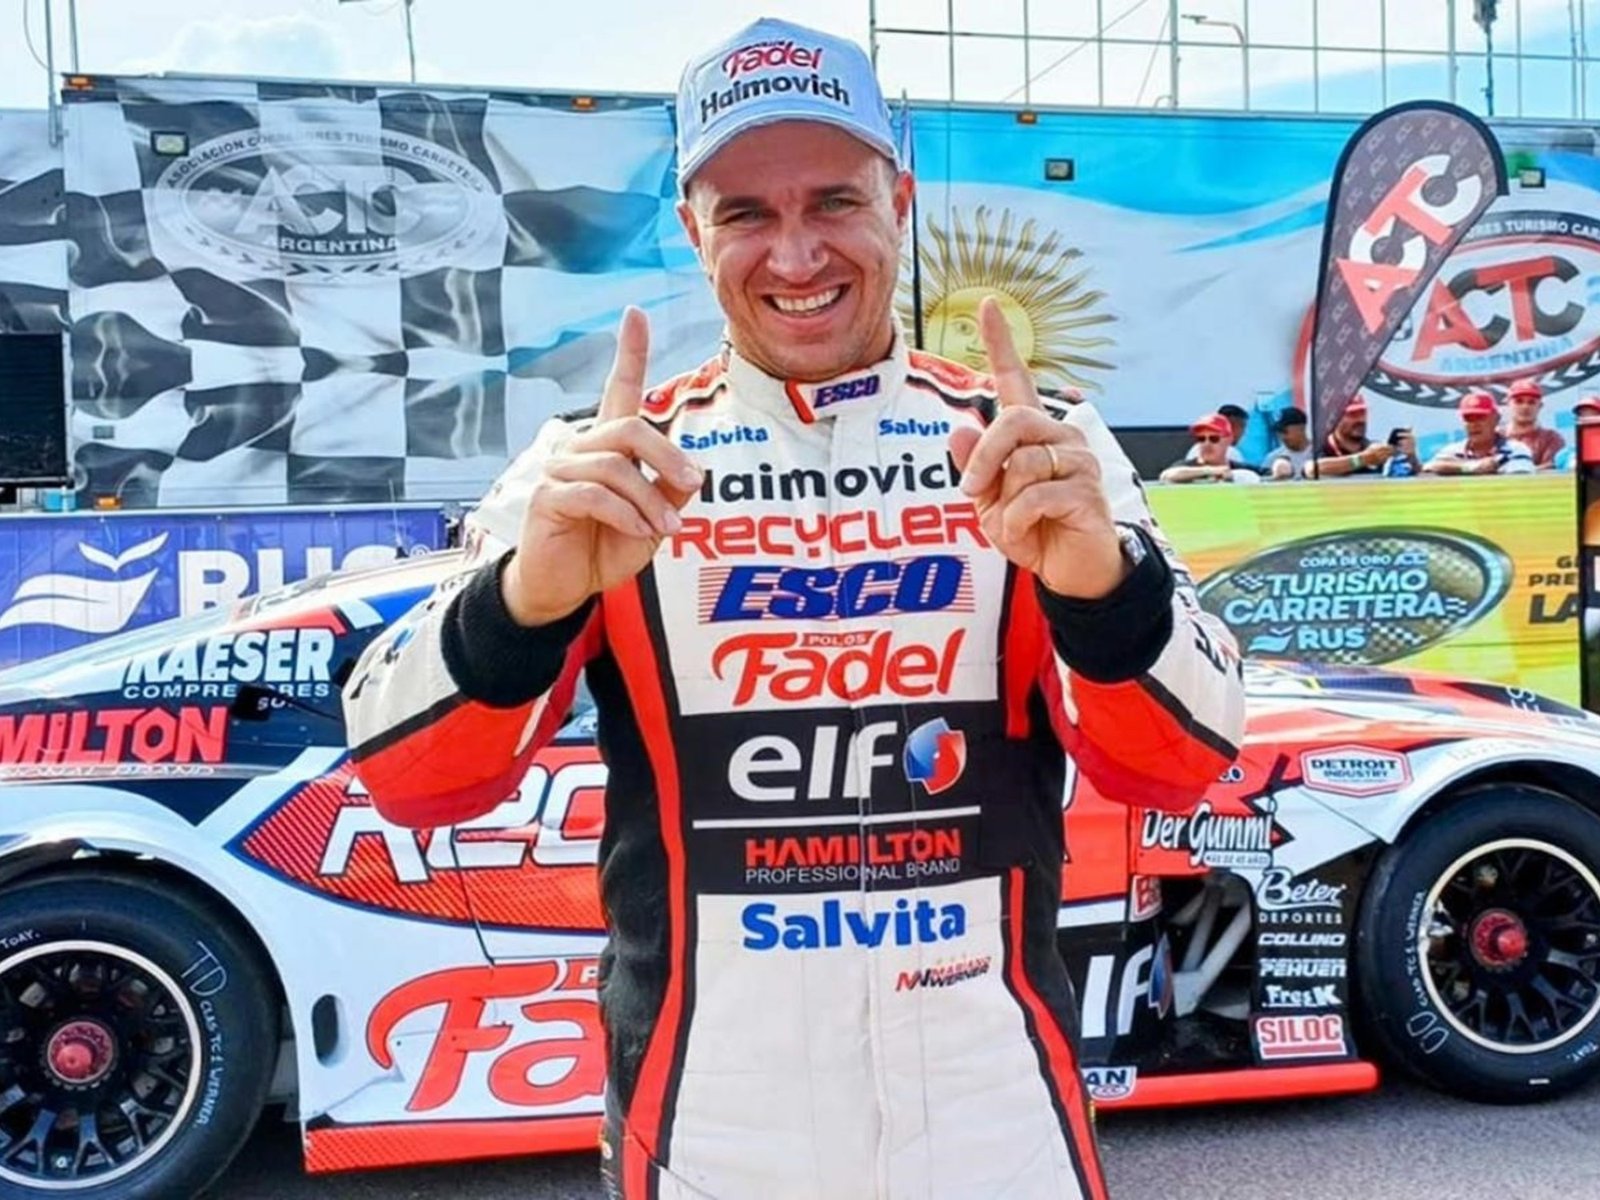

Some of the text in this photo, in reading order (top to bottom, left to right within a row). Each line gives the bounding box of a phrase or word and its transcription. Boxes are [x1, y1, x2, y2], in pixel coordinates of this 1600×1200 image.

[722, 41, 822, 78] Fadel
[701, 74, 850, 123] Haimovich
[166, 137, 245, 188] ASOCIACION
[1505, 219, 1569, 234] TURISMO
[1336, 154, 1482, 335] ACTC
[1411, 256, 1586, 362] ACTC
[813, 375, 880, 408] ESCO
[680, 425, 769, 449] Salvita
[1300, 556, 1337, 568] COPA
[1360, 554, 1392, 566] ORO
[710, 555, 965, 622] ESCO
[1268, 569, 1429, 599] TURISMO
[1224, 592, 1447, 625] CARRETERA
[808, 633, 868, 647] POLOS
[1297, 626, 1366, 651] RUS
[712, 628, 967, 707] Fadel
[123, 682, 330, 699] COMPRERES
[728, 720, 898, 801] elf
[1311, 759, 1397, 769] DETROIT
[1323, 770, 1388, 778] INDUSTRY
[1141, 810, 1188, 849] Der
[745, 828, 961, 867] HAMILTON
[746, 858, 961, 884] PROFESSIONAL BRAND
[741, 898, 966, 951] Salvita
[1258, 912, 1343, 925] DEPORTES
[1257, 932, 1347, 947] COLLINO
[1260, 1015, 1341, 1044] SILOC
